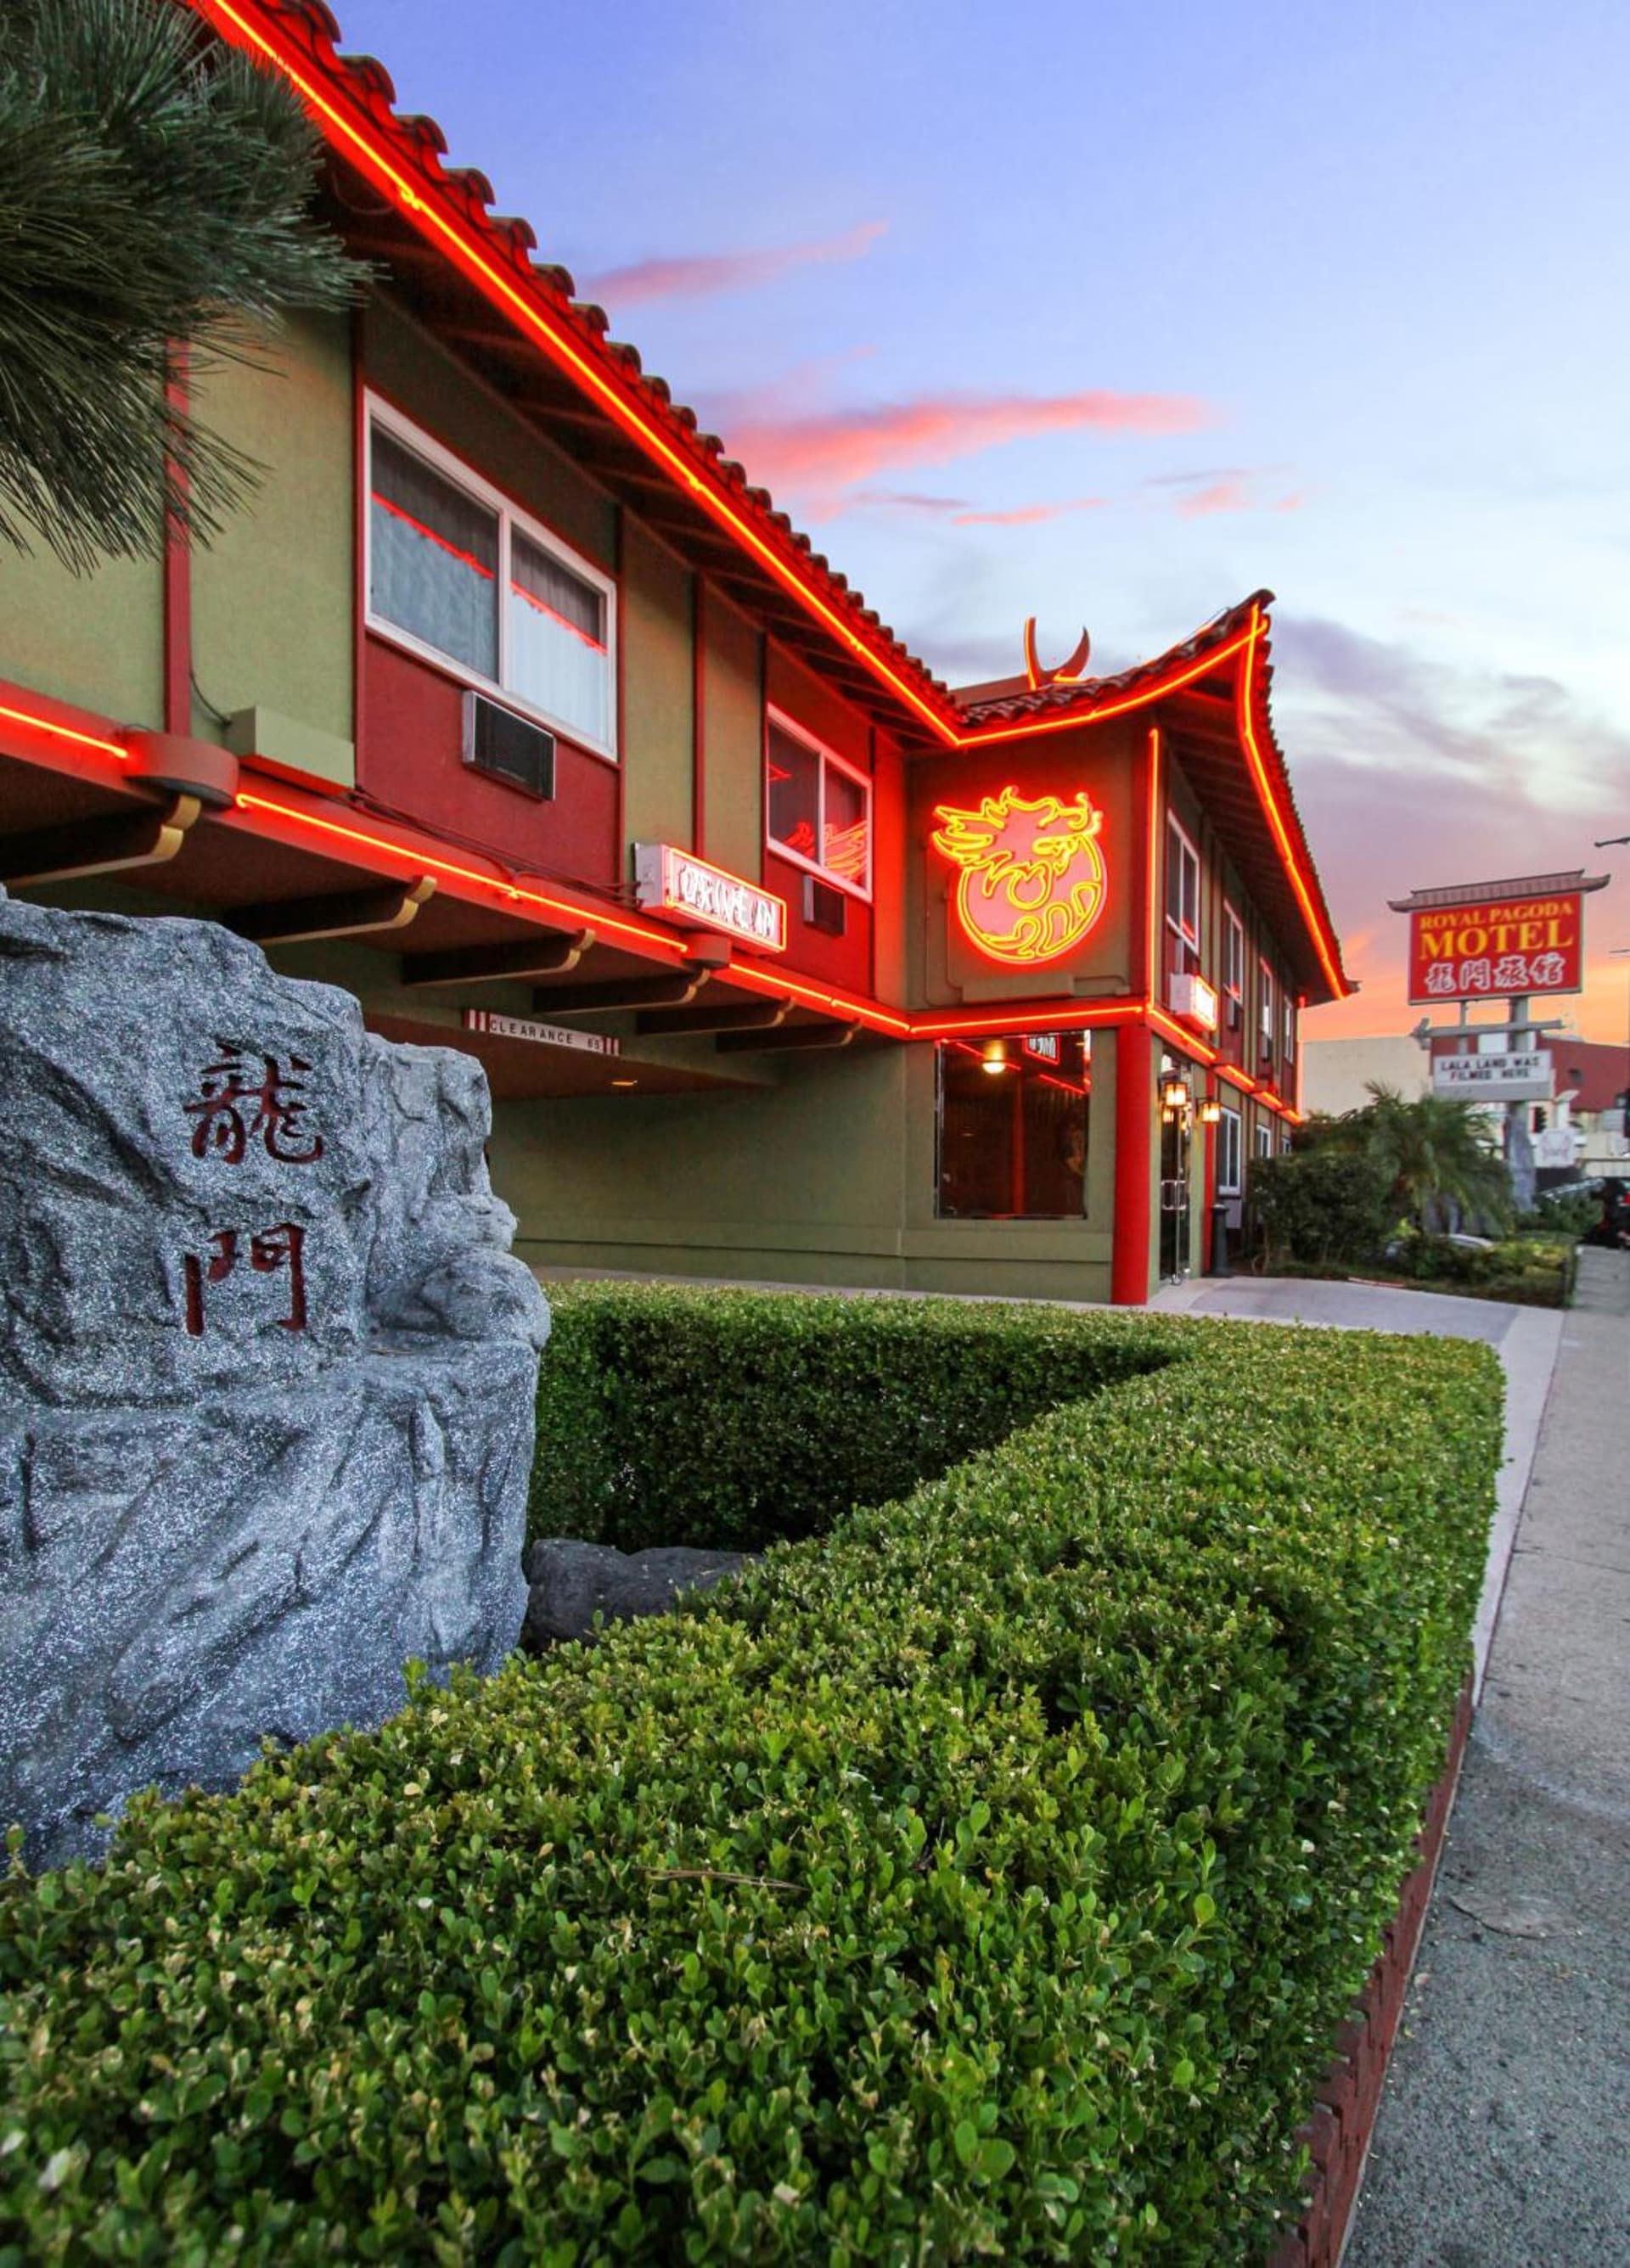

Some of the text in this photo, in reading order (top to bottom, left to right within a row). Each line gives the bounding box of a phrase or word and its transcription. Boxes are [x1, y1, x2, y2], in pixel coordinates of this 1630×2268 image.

[1419, 901, 1573, 931] ROYAL PAGODA
[1419, 919, 1573, 960] MOTEL
[490, 1019, 573, 1044] CLEARANCE
[1441, 1056, 1540, 1071] LALA LAND WAS
[1450, 1069, 1492, 1081] FILMED
